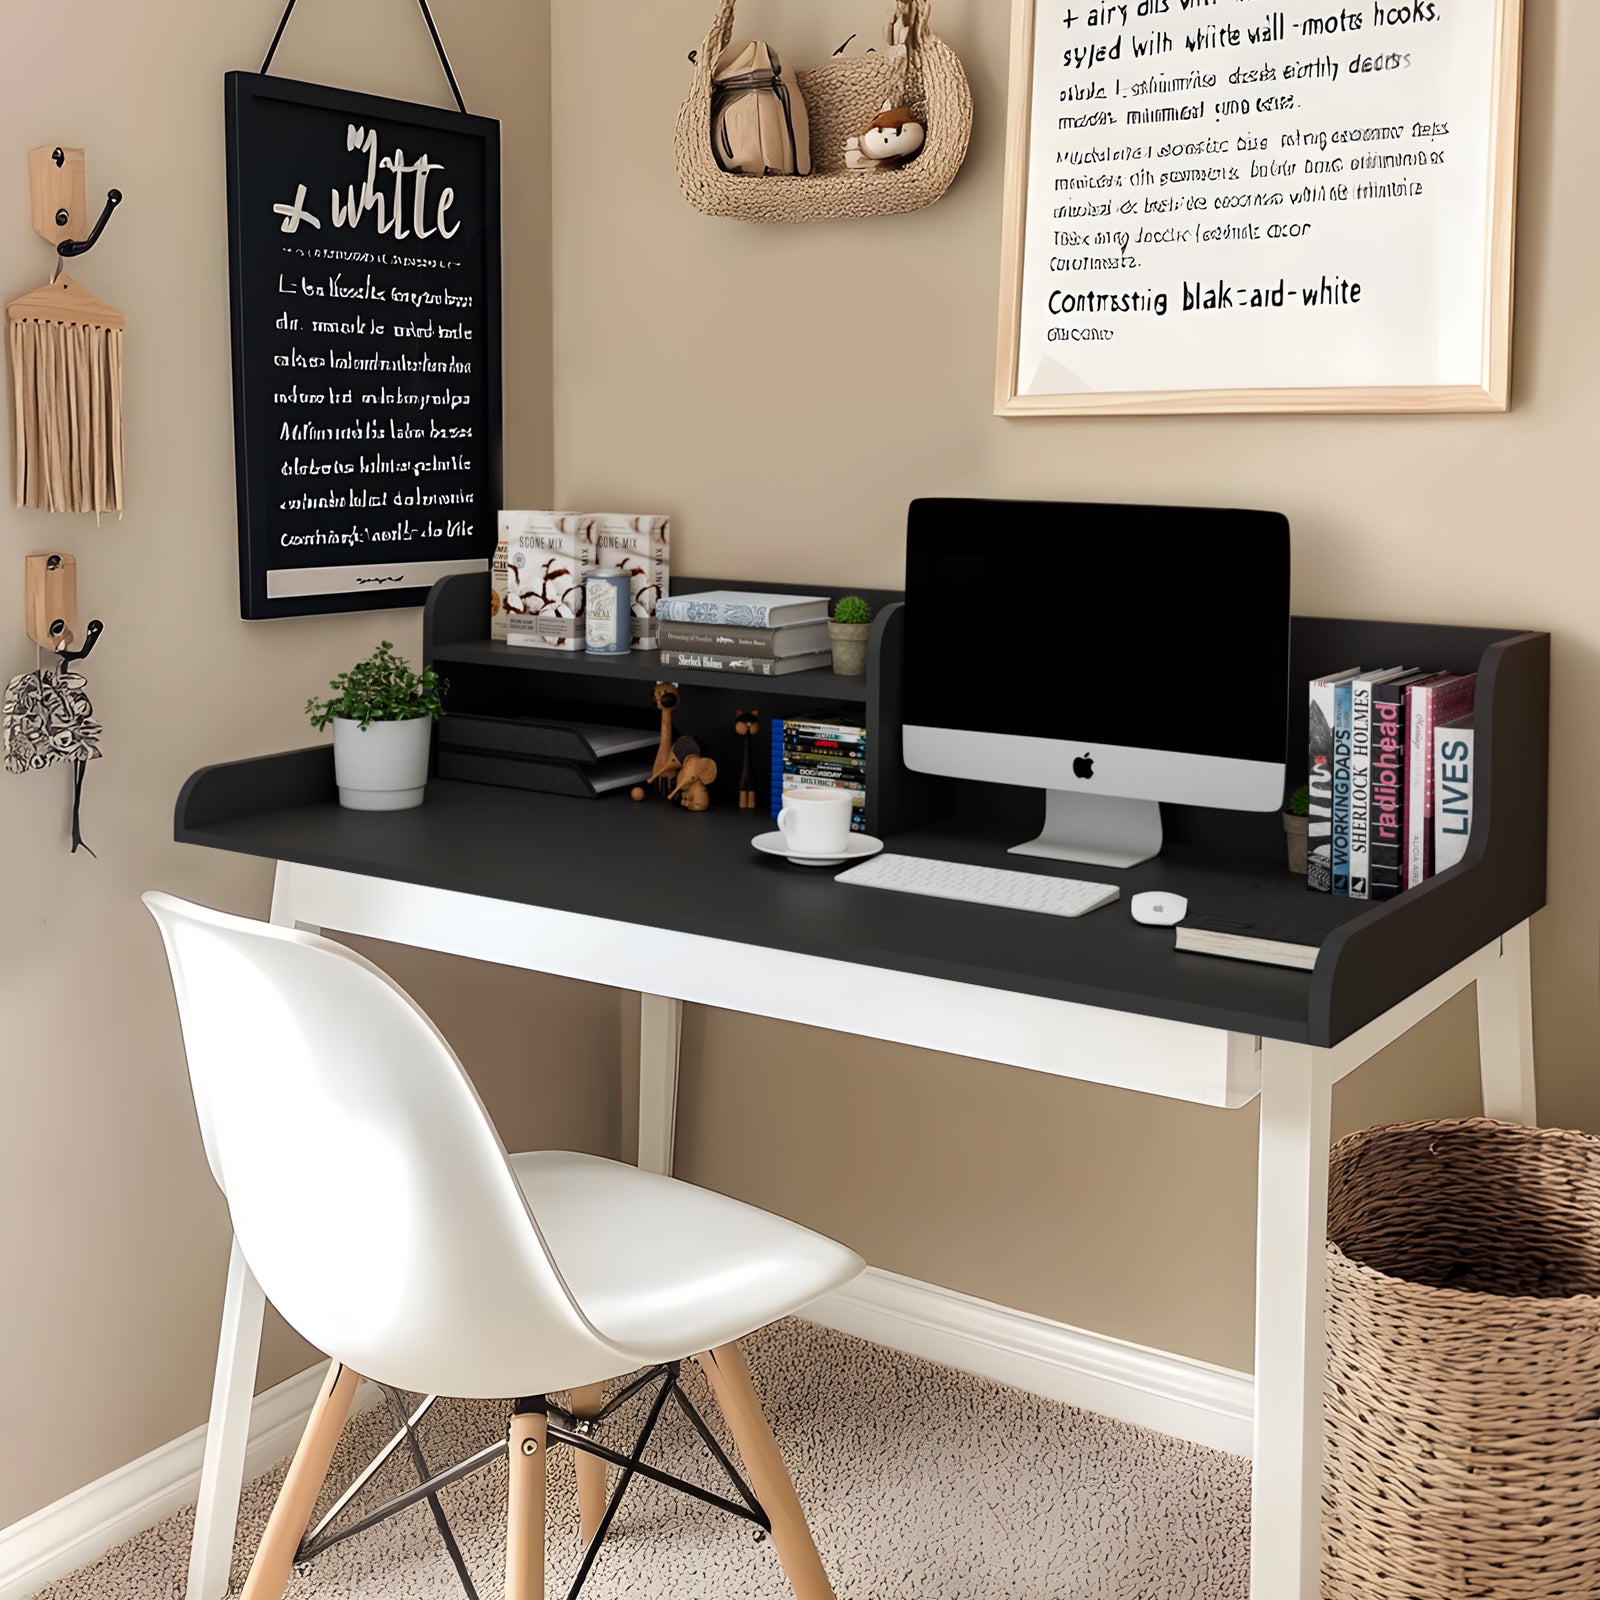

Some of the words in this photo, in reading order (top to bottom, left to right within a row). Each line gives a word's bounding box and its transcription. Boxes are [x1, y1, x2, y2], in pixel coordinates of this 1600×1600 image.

[519, 535, 545, 549] SCONE
[547, 538, 563, 550] MIX
[622, 537, 638, 550] MIX
[1334, 729, 1351, 780] DAD'S
[1353, 688, 1369, 757] HOLMES
[800, 776, 834, 788] DISTRICT
[1373, 703, 1398, 839] radiohead
[1441, 739, 1469, 836] LIVES
[1333, 783, 1350, 866] WORKING
[1352, 766, 1368, 854] SHERLOCK
